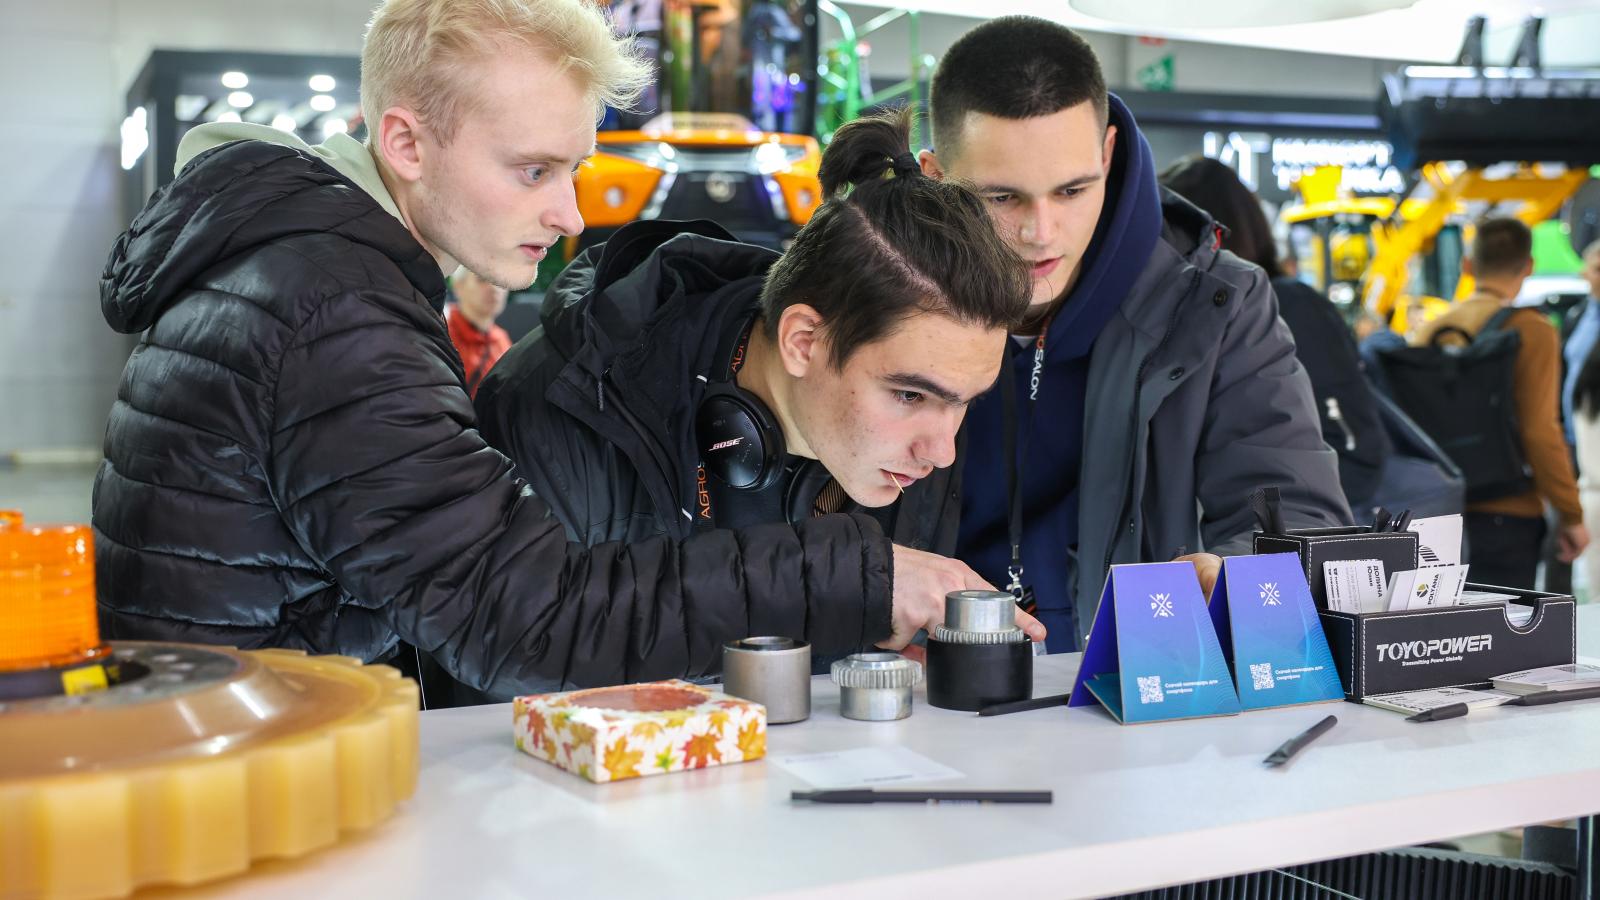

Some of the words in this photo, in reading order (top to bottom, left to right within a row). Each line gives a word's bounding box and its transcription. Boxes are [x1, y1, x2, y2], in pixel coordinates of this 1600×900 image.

[709, 437, 744, 451] BOSE
[1373, 565, 1383, 598] ДОЛИНА
[1428, 574, 1440, 605] POLYANA
[1376, 634, 1493, 662] TOYOPOWER
